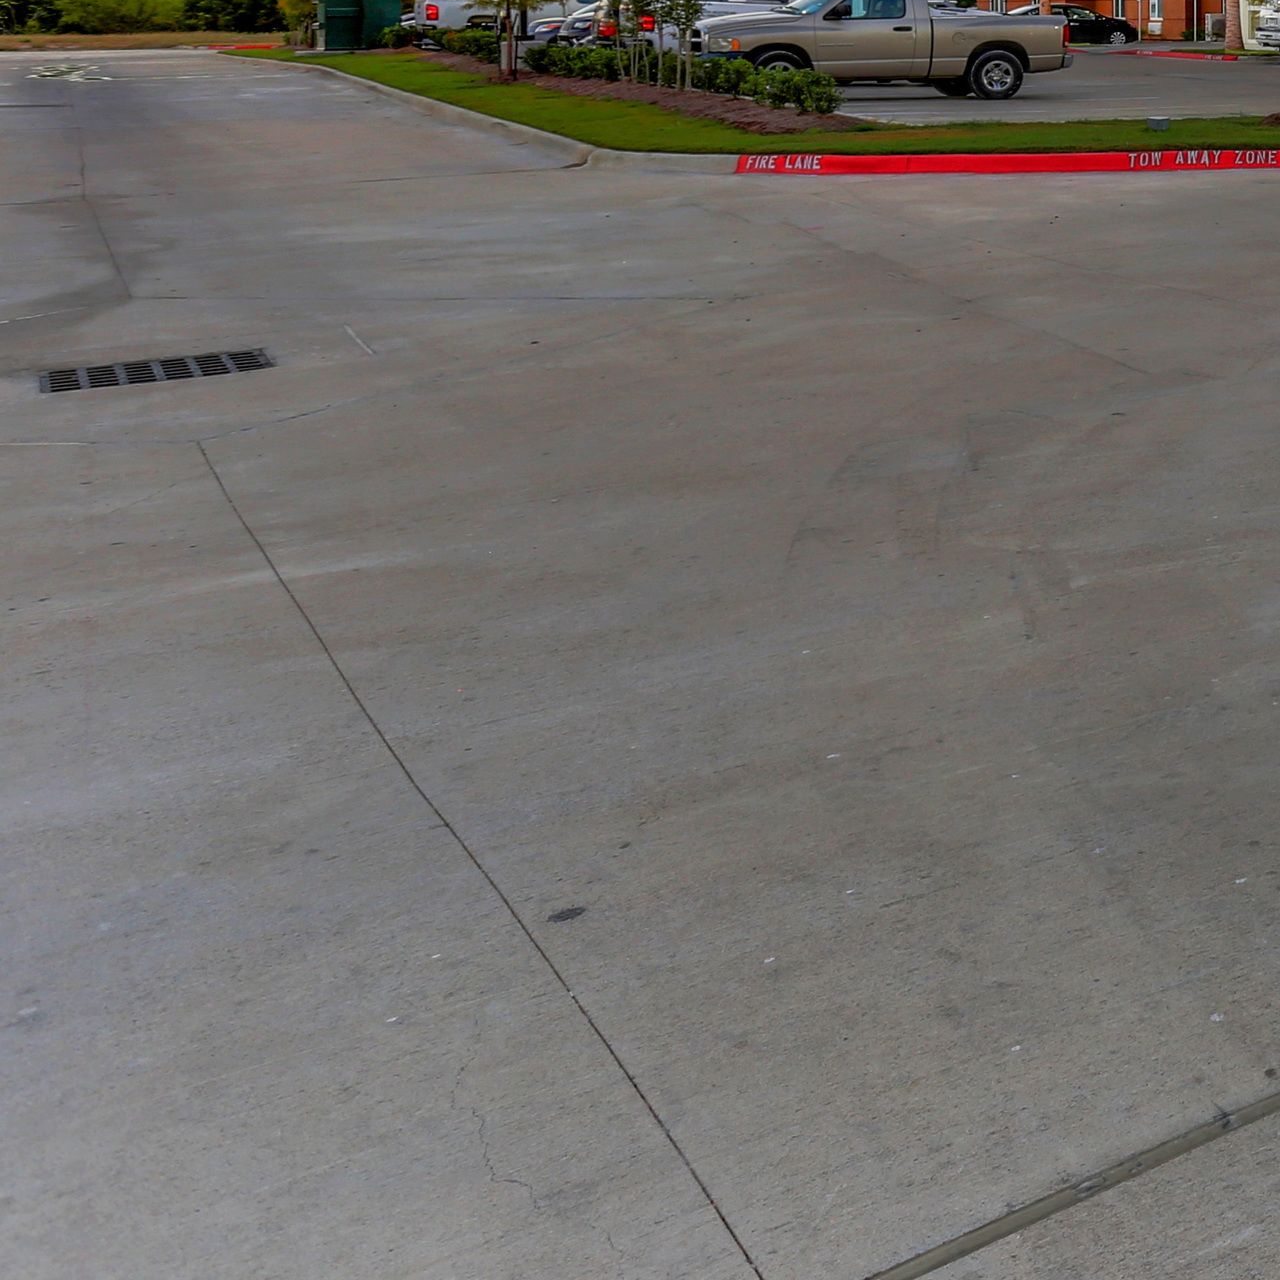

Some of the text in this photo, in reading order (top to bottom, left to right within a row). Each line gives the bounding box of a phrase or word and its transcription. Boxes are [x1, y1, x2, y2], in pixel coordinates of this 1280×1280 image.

[745, 155, 822, 170] FIRE LANE
[1128, 150, 1278, 168] TOW AWAY ZONE
